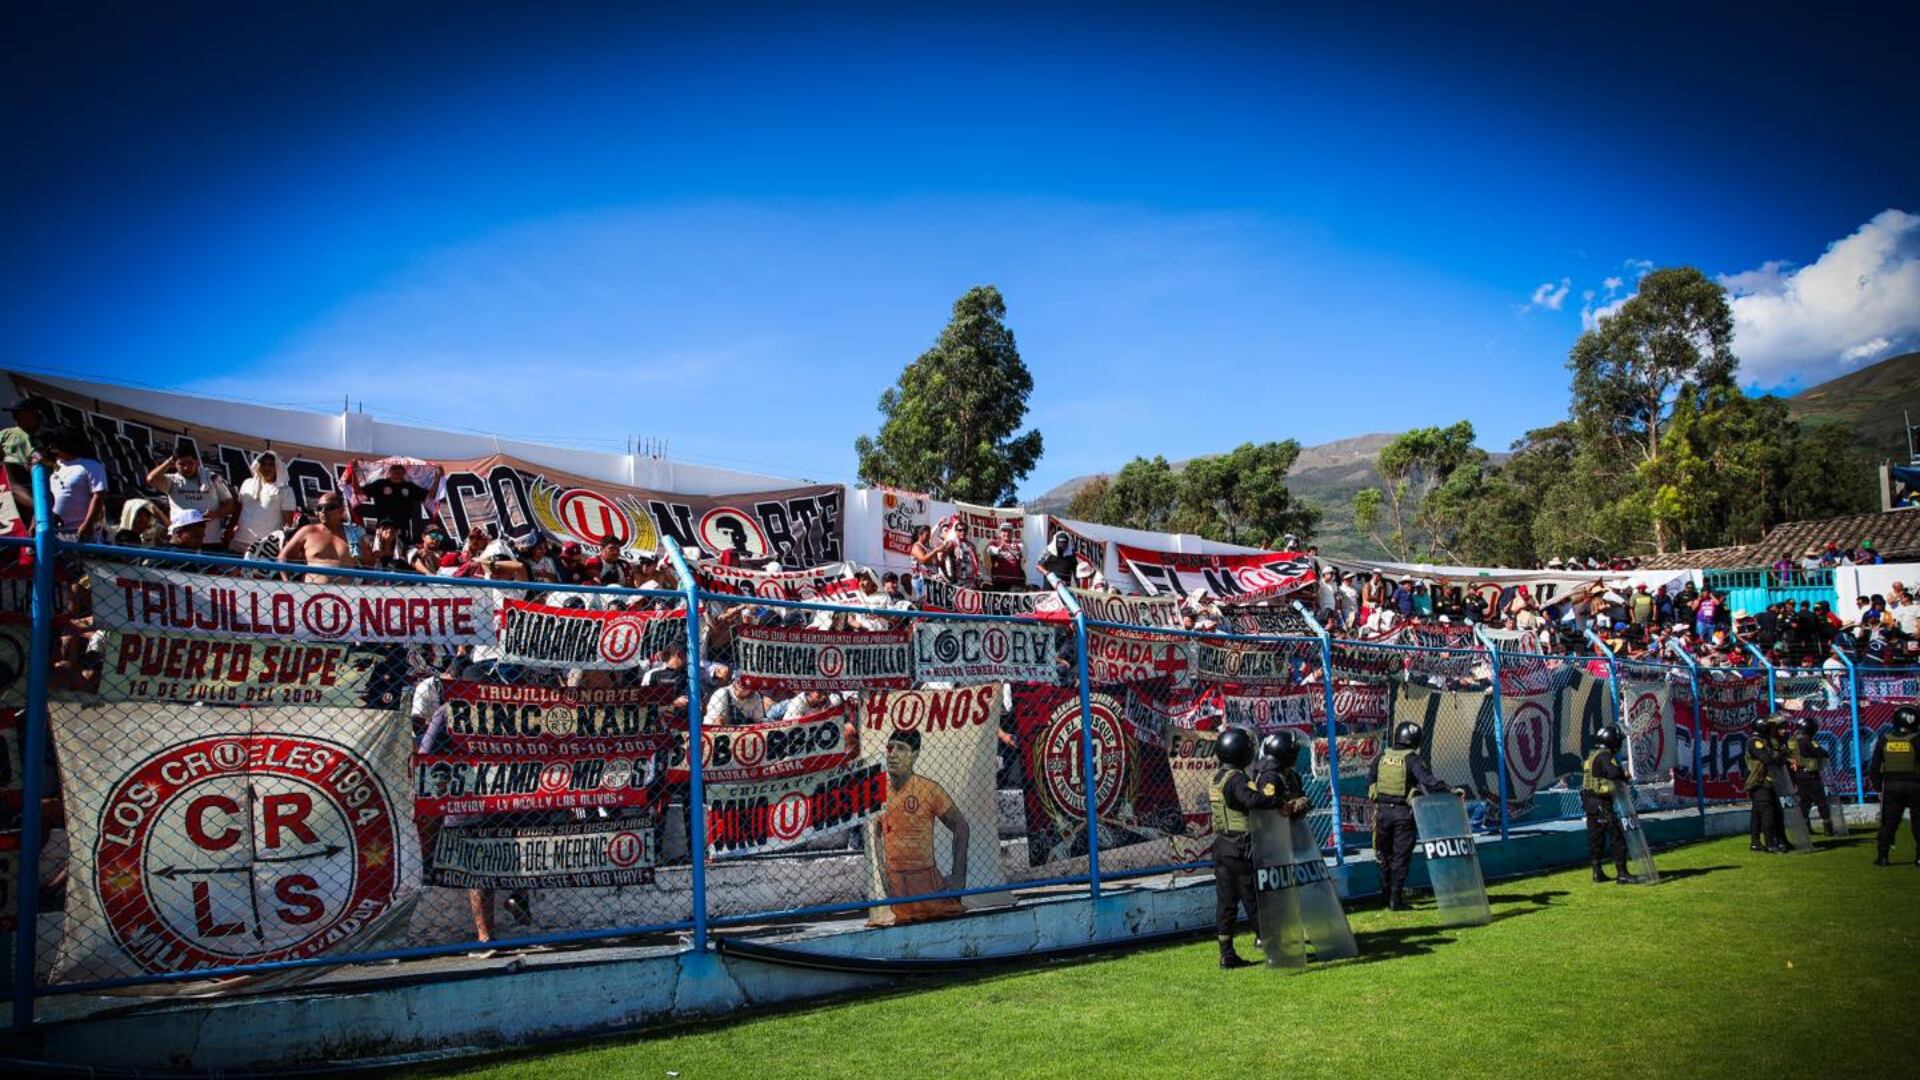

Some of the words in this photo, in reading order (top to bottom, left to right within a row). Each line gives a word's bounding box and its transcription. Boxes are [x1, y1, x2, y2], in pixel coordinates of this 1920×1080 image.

[116, 577, 296, 635] TRUJILLO
[359, 597, 476, 638] NORTE
[925, 579, 956, 609] THE
[981, 593, 1035, 616] VEGAS
[504, 607, 601, 663] CAJABAMBA
[1088, 634, 1153, 664] RIGADA
[116, 633, 253, 683] PUERTO
[258, 645, 342, 686] SUPE
[743, 642, 817, 676] FLORENCIA
[845, 647, 906, 676] TRUJILLO
[158, 681, 179, 698] DE
[187, 683, 236, 701] JULIO
[246, 687, 275, 702] DEL
[477, 684, 561, 702] TRUJILLO
[582, 686, 641, 702] NORTE
[105, 783, 159, 847] LOS
[331, 761, 382, 827] 1994
[730, 775, 814, 797] CHICLAYO
[184, 794, 242, 852] C
[262, 791, 323, 849] R
[525, 840, 548, 872] DEL
[192, 880, 246, 938] L
[274, 873, 326, 926] S
